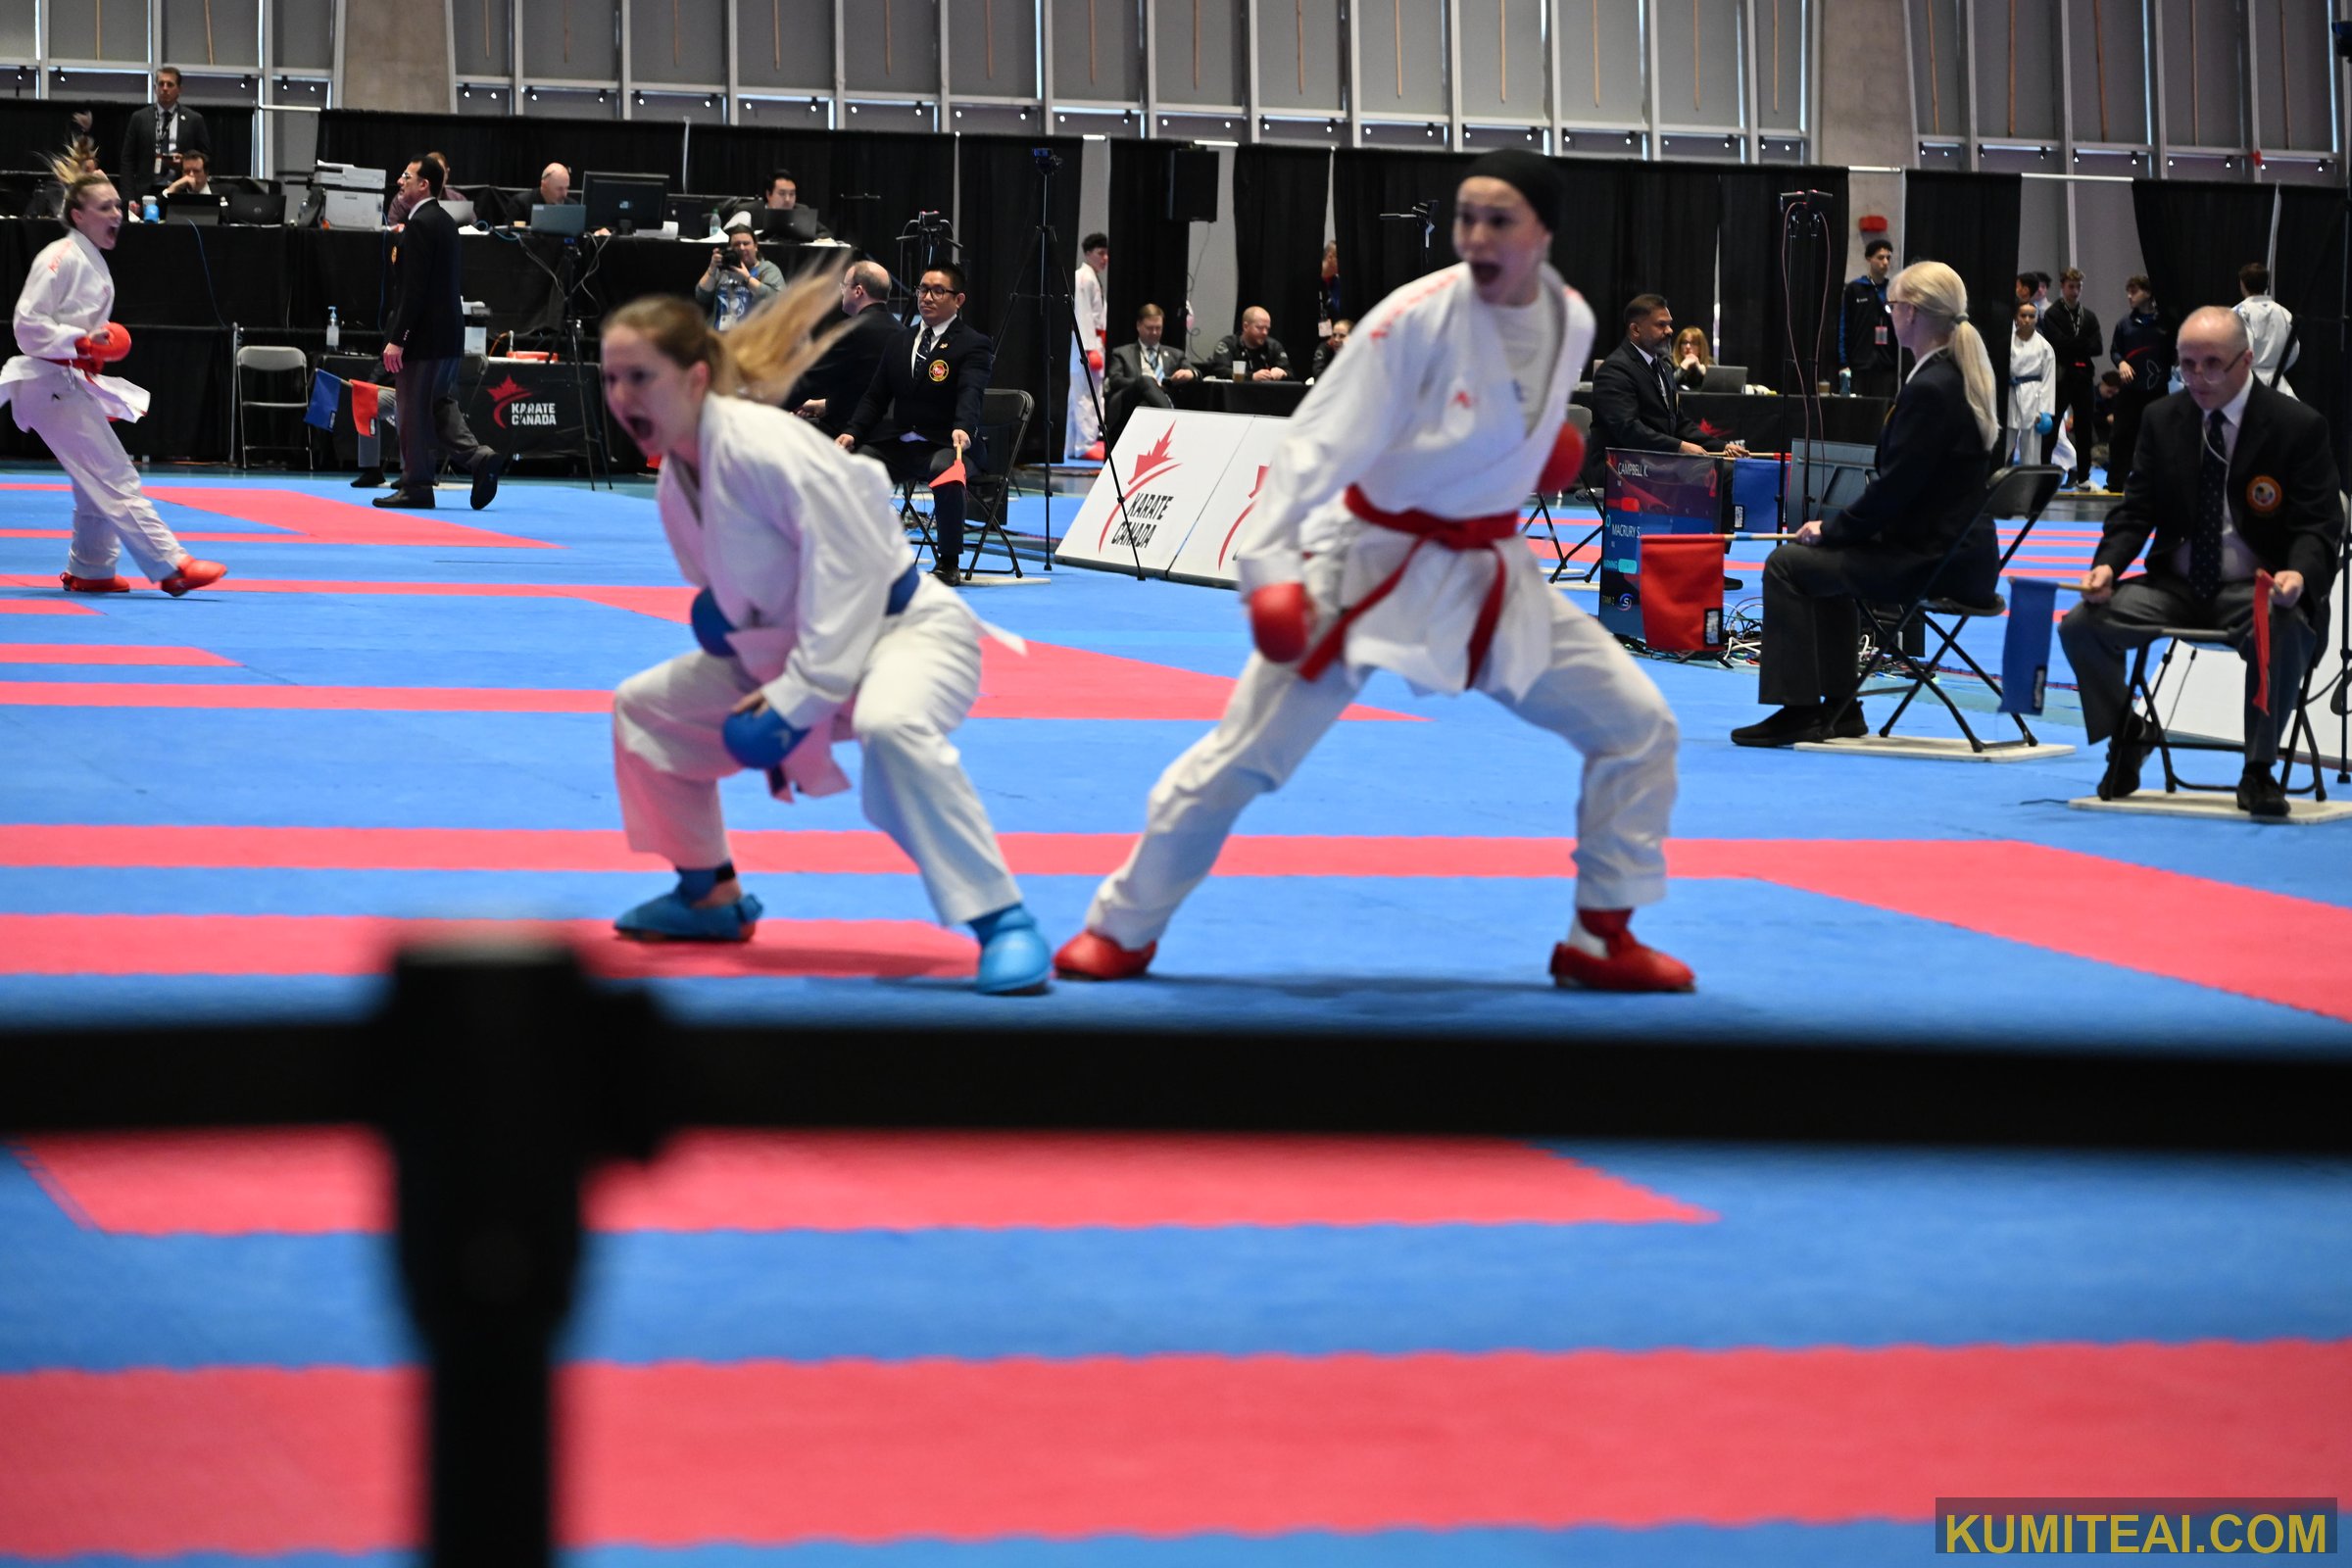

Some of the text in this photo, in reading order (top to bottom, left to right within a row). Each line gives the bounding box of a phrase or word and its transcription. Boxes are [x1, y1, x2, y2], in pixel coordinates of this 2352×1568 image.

[511, 403, 556, 415] KARATE
[511, 414, 557, 425] CANADA
[1617, 463, 1642, 477] CAMPBELL
[1127, 493, 1174, 520] KARATE
[1111, 521, 1157, 549] CANADA
